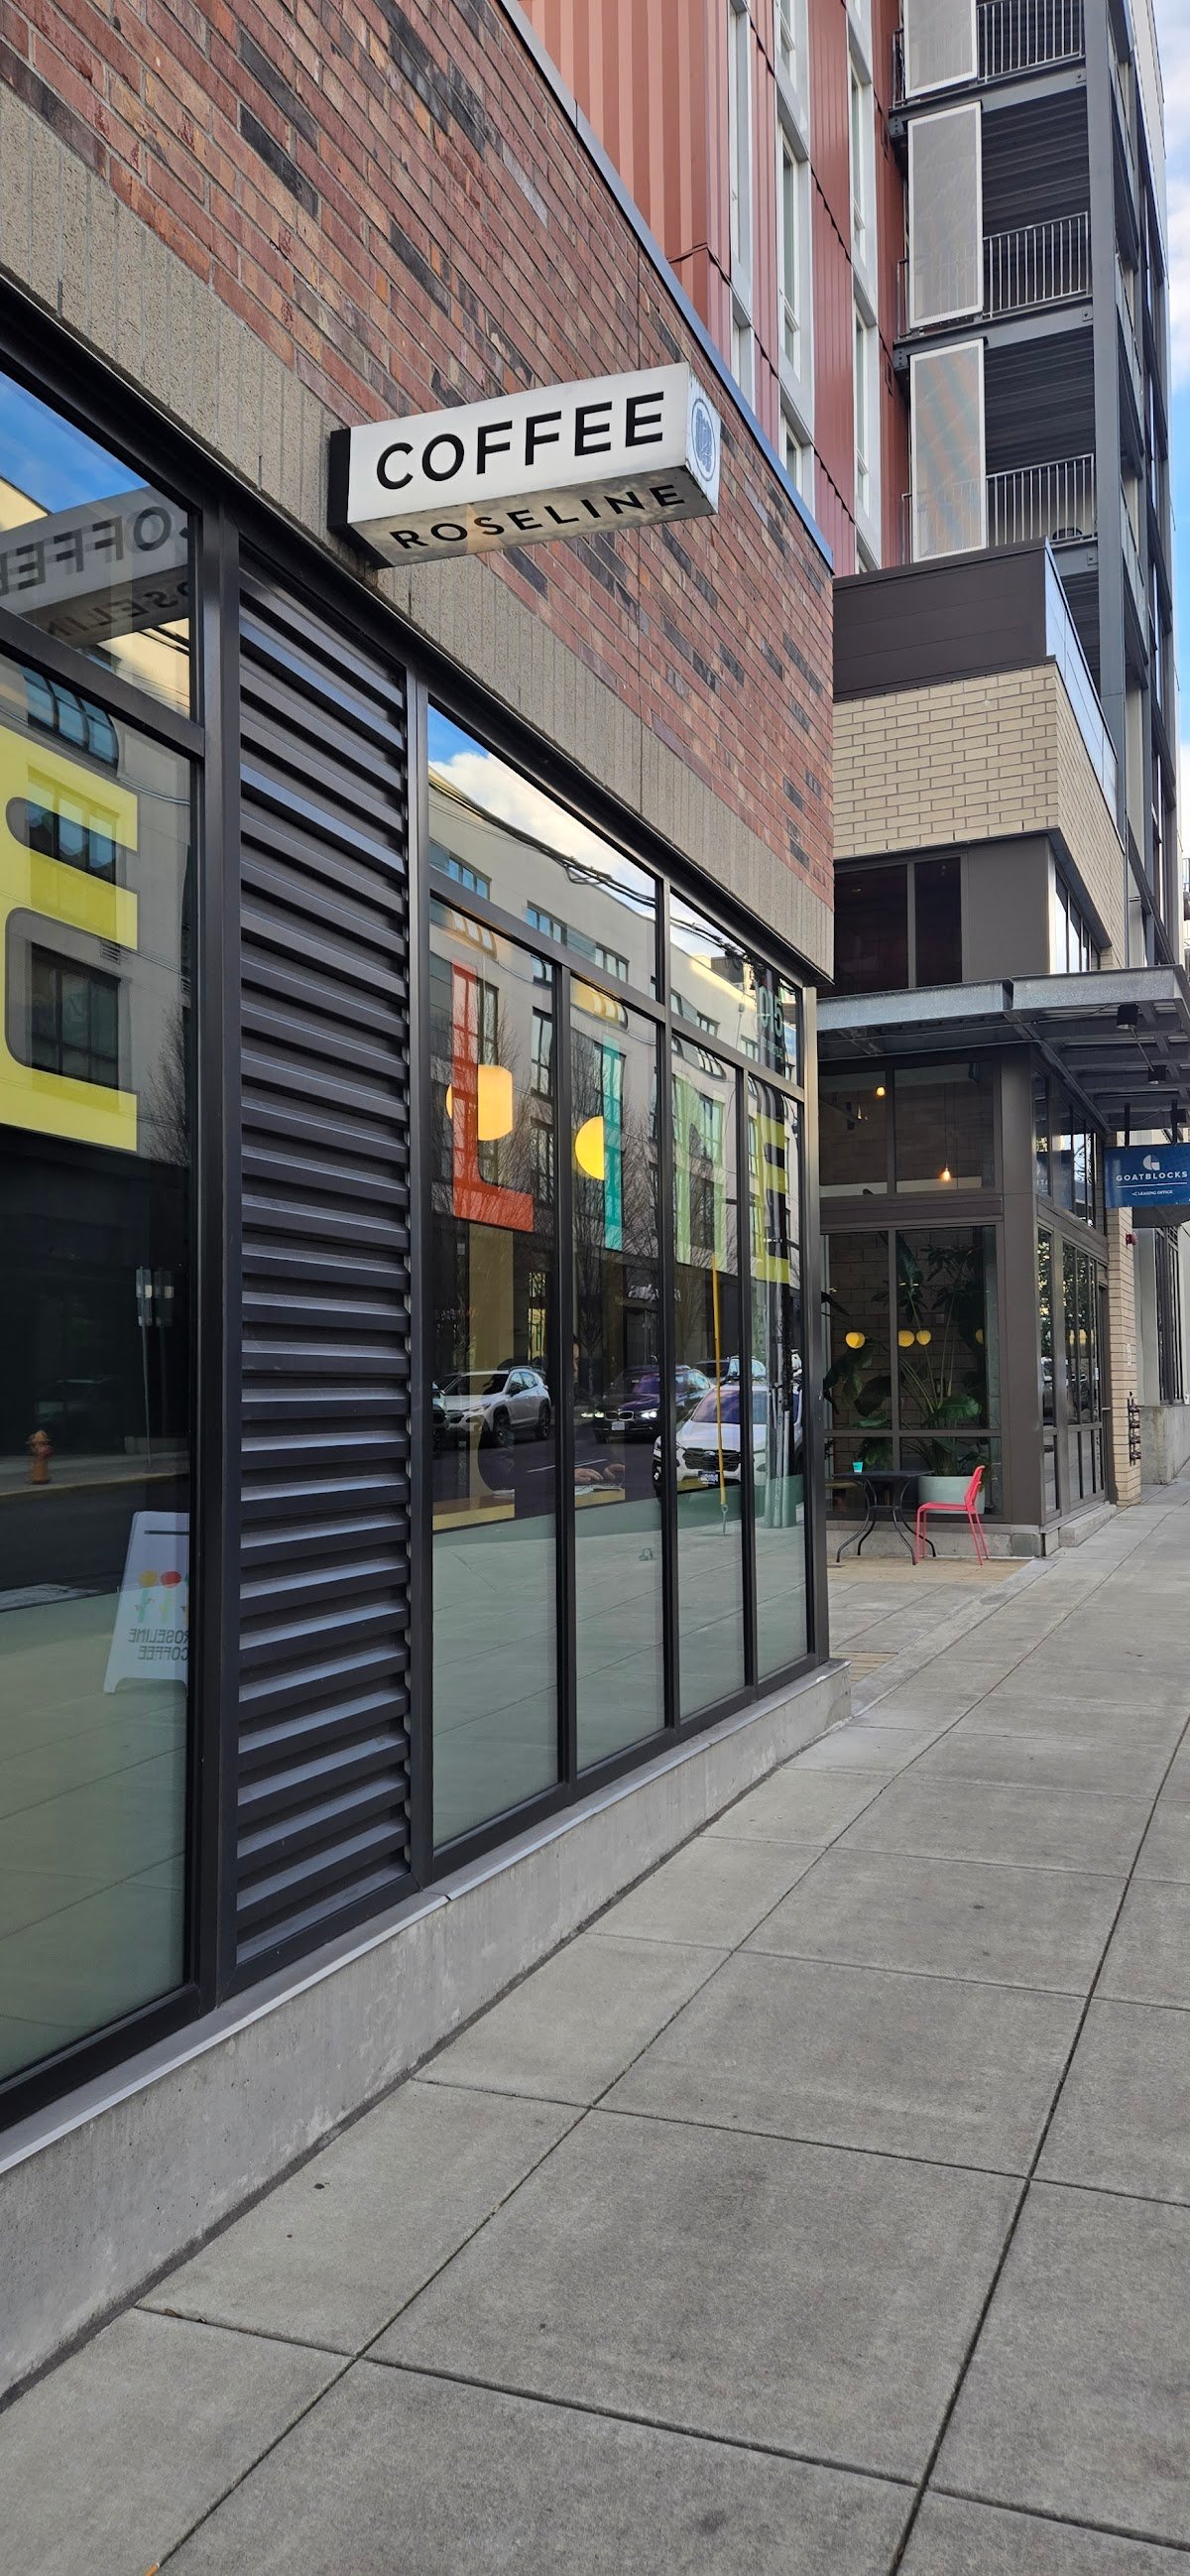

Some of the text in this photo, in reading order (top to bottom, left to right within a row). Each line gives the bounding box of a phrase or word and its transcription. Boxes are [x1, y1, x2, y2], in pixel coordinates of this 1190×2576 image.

[376, 391, 664, 490] COFFEE
[390, 484, 685, 550] ROSELINE
[1116, 1170, 1188, 1181] GOATBLOCKS
